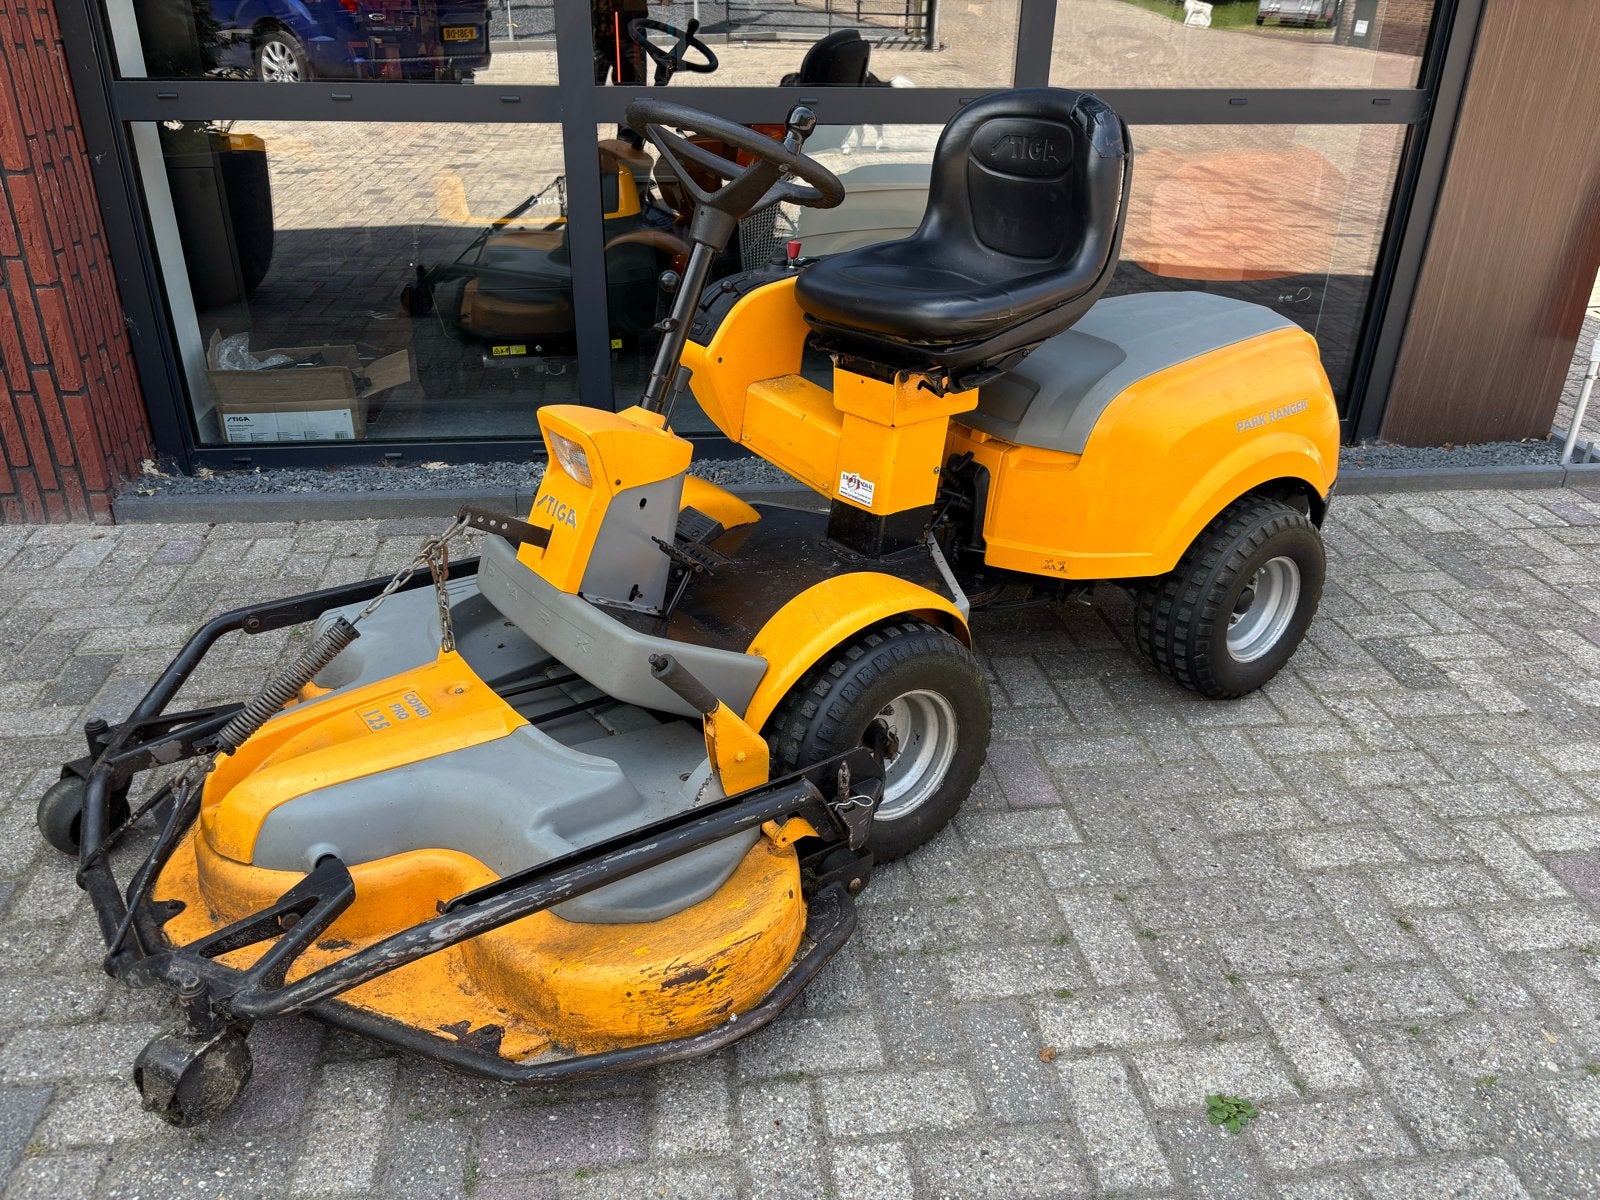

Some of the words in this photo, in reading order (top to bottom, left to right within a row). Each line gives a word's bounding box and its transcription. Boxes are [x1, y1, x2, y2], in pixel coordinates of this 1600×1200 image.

[990, 134, 1060, 164] STIGA
[1236, 414, 1267, 433] PARK
[1268, 400, 1308, 422] RANGER
[536, 494, 576, 529] STIGA
[362, 709, 391, 731] 125
[388, 703, 410, 720] PRO
[403, 693, 432, 719] COMBI
